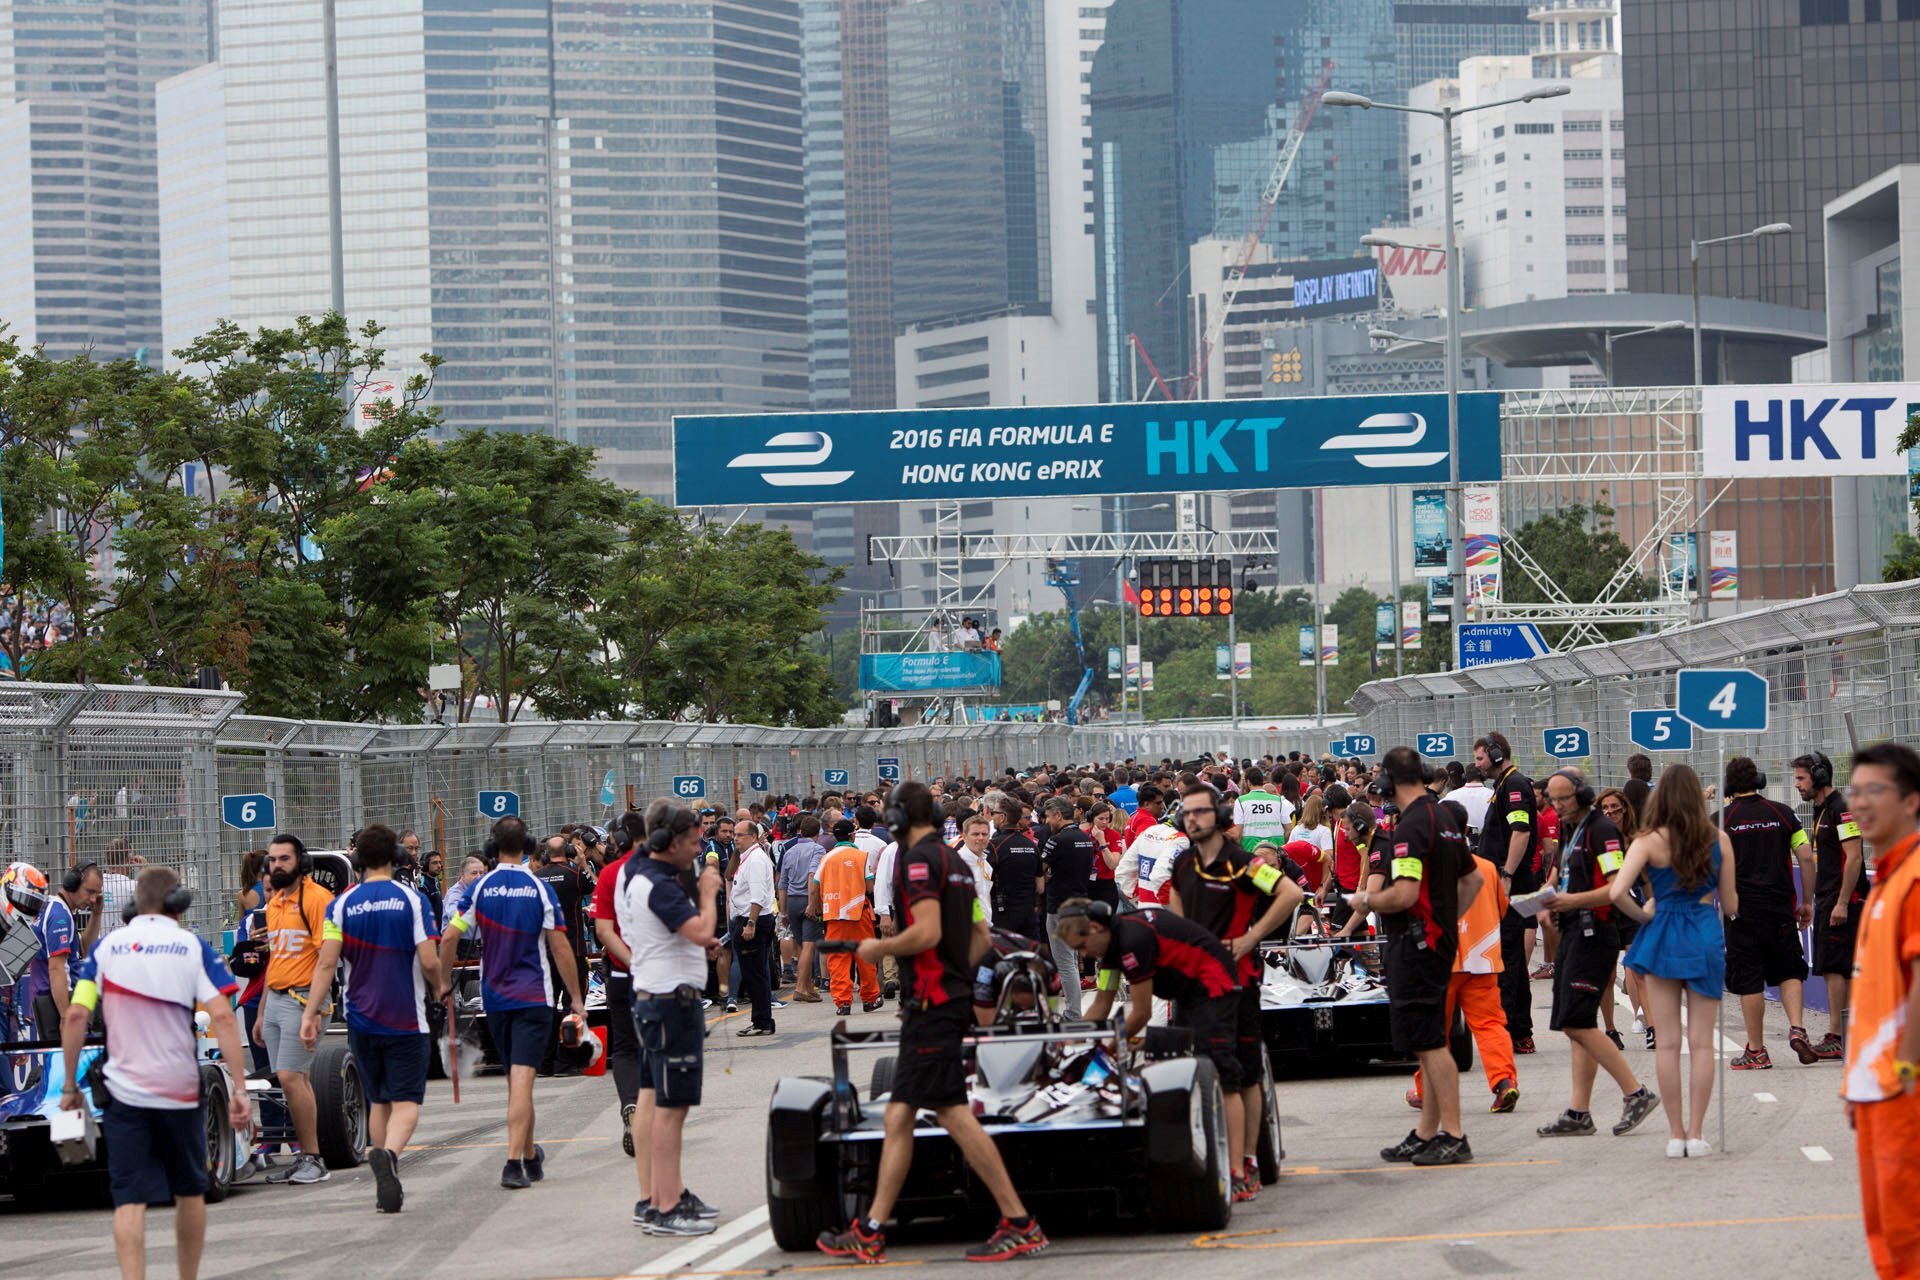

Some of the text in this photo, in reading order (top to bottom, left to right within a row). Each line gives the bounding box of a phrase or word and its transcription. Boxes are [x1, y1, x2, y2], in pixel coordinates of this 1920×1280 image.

[1294, 268, 1377, 307] DISPLAY INFINITY
[890, 424, 1114, 449] 2016 FIA FORMULA E
[1735, 398, 1897, 461] HKT
[1146, 417, 1286, 475] HKT
[902, 459, 1103, 484] HONG KONG ePRIX
[1463, 626, 1512, 636] Admiralty
[902, 656, 950, 667] Formula E
[1708, 682, 1737, 719] 4
[1653, 717, 1672, 742] 5
[1353, 738, 1370, 751] 19
[1426, 737, 1447, 752] 25
[1554, 733, 1580, 753] 23
[829, 772, 844, 782] 37
[886, 767, 893, 776] 3
[679, 780, 699, 794] 66
[755, 776, 762, 788] 9
[493, 795, 507, 812] 8
[1252, 804, 1273, 815] 296
[241, 801, 257, 823] 6
[1730, 821, 1780, 832] VENTURI
[507, 885, 538, 898] amlin
[372, 897, 405, 911] amlin
[144, 942, 189, 956] amlin
